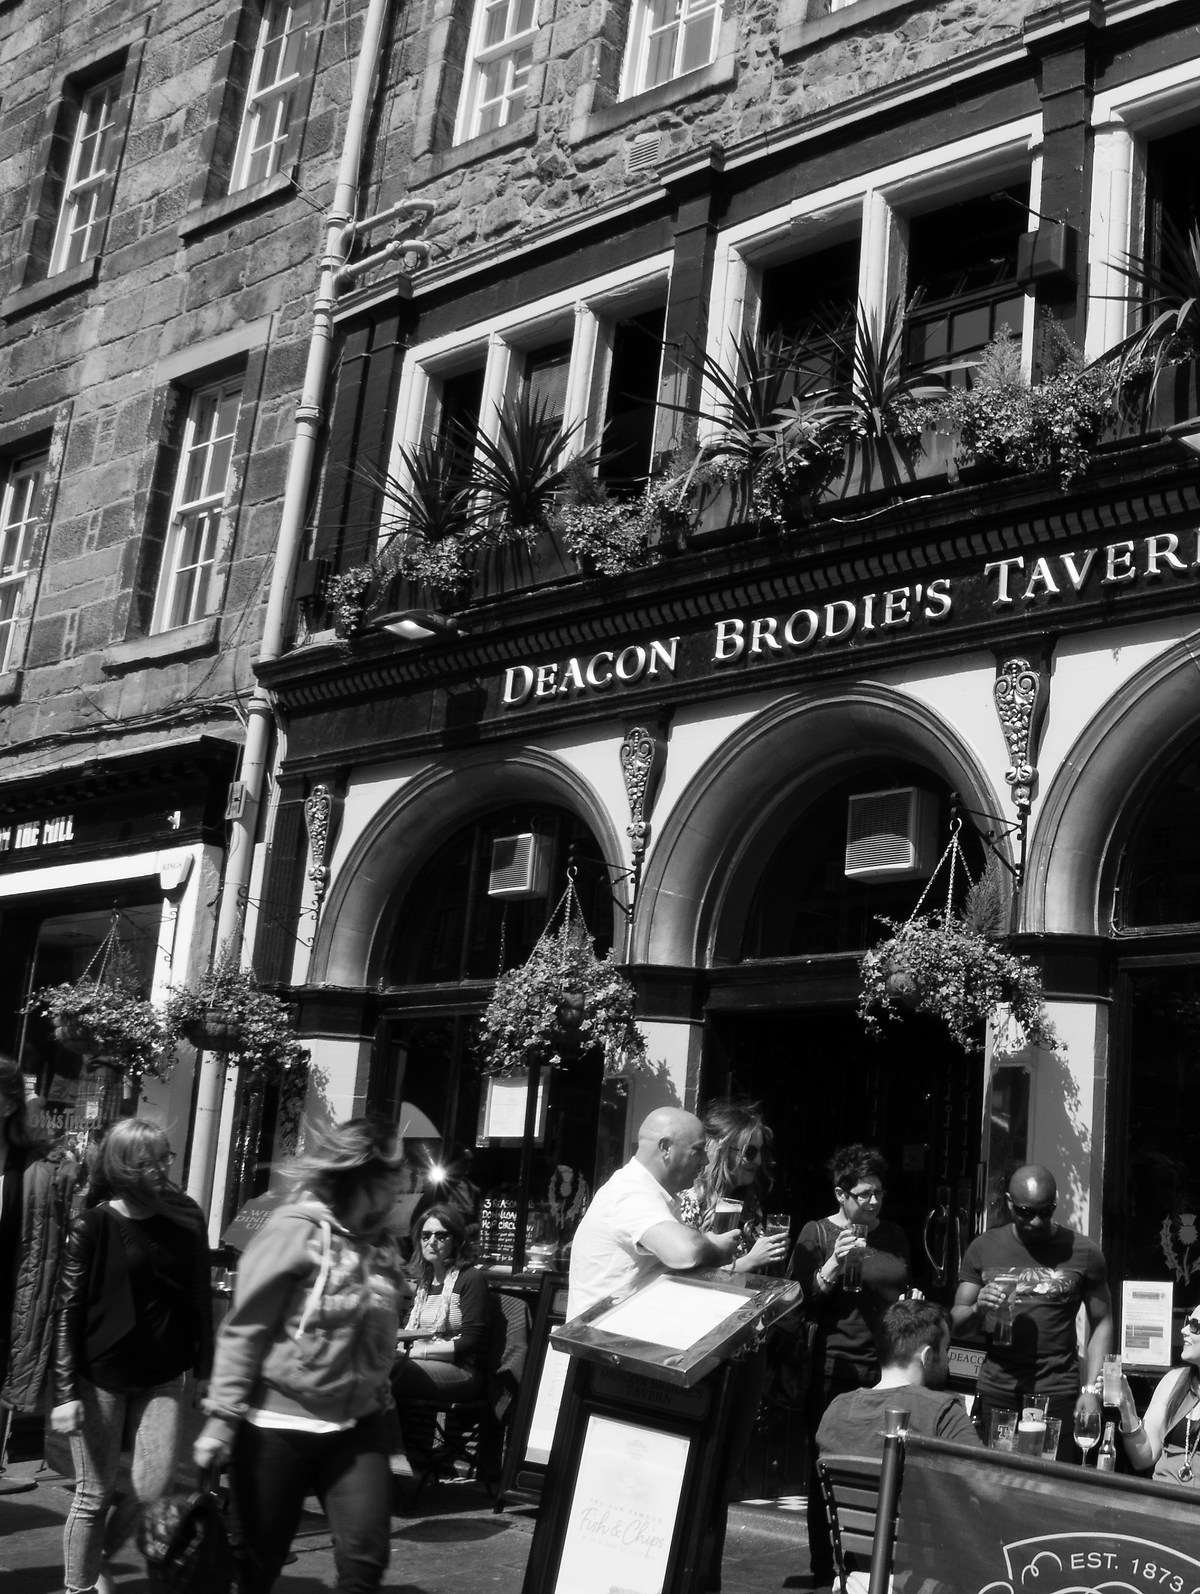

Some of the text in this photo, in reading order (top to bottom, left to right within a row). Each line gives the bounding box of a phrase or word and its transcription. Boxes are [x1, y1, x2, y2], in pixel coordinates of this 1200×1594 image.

[501, 636, 680, 704] DEACON
[711, 579, 952, 662] BRODIE'S
[14, 820, 40, 849] THE
[42, 814, 75, 845] MILL
[483, 1199, 492, 1209] 3
[950, 1351, 984, 1365] DEACO
[579, 1507, 612, 1534] Fish
[610, 1519, 624, 1538] &
[621, 1519, 666, 1559] Chips
[1070, 1553, 1184, 1593] EST. 1873
